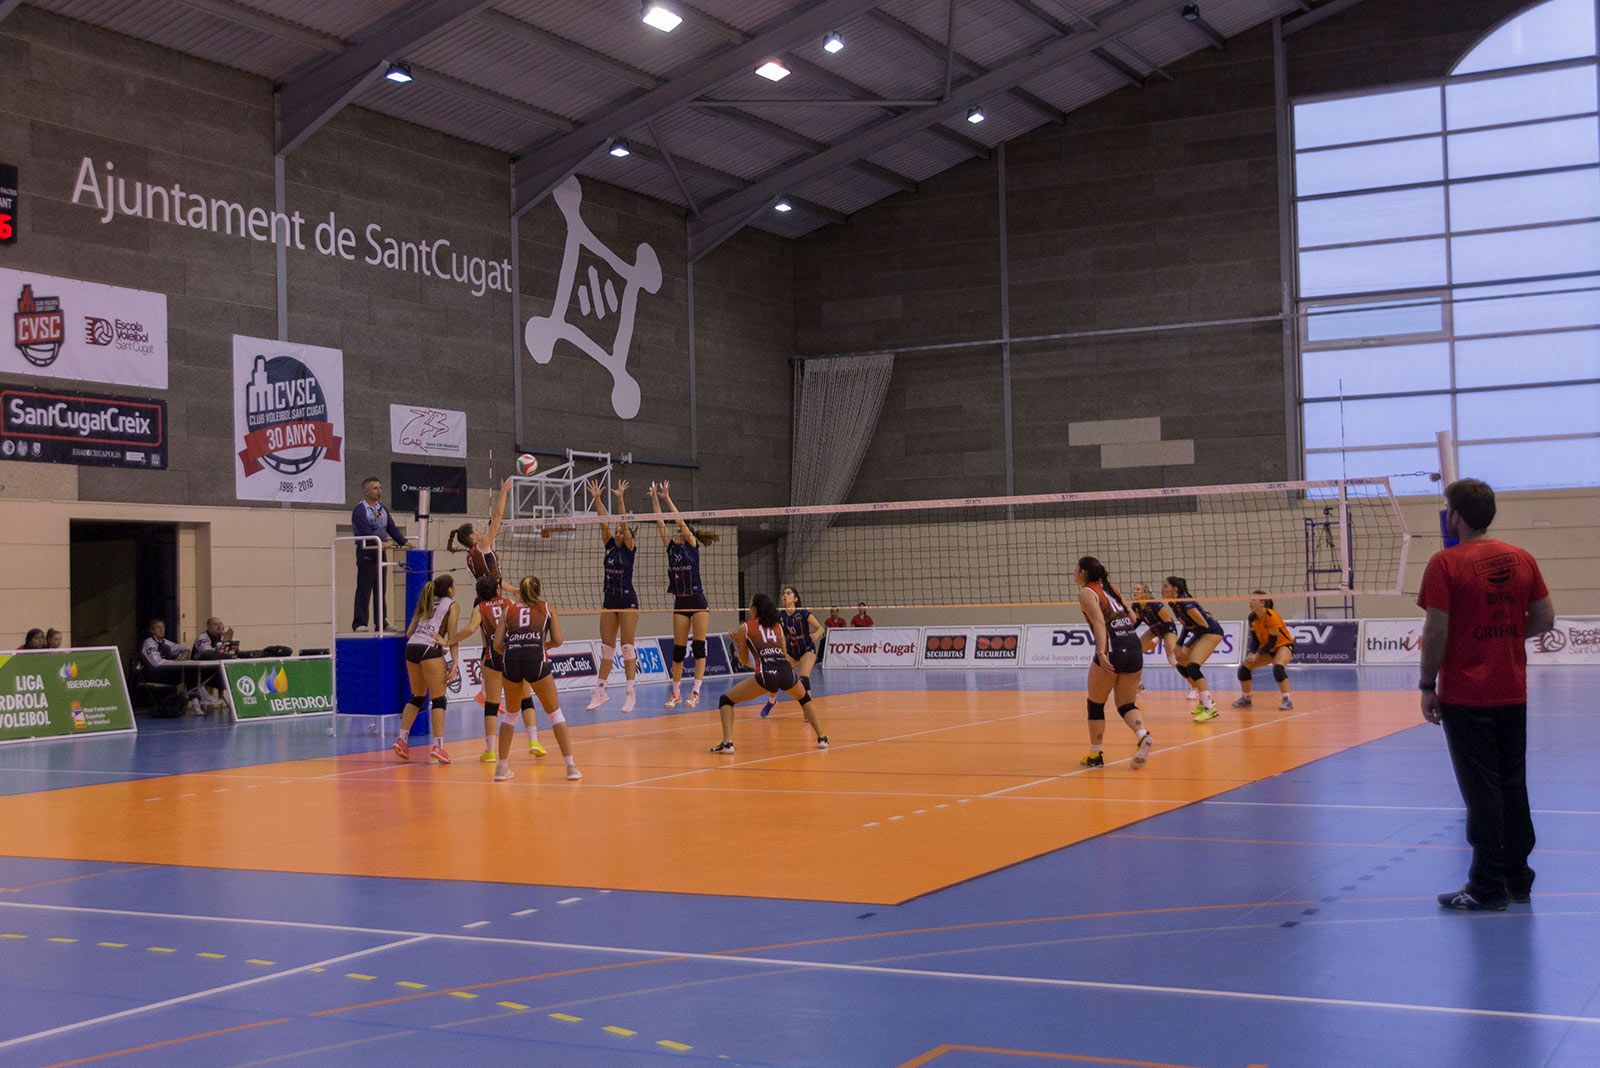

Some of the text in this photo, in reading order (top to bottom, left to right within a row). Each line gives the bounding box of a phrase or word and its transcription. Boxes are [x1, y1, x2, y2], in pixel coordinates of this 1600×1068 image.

[72, 156, 512, 297] Ajuntament de SantCugat
[19, 315, 61, 341] CVSC
[115, 318, 143, 331] Escola
[116, 328, 149, 343] Voleibol
[275, 376, 316, 409] CVSC
[10, 398, 151, 436] SantCugatCreix
[250, 404, 325, 425] CLUB VOLEIBOL SANT CUGAT
[266, 423, 316, 450] 30 ANYS
[279, 480, 293, 493] 1988
[298, 478, 314, 492] 2018
[519, 607, 530, 627] 6
[509, 631, 541, 641] GRIFOLS
[758, 624, 777, 643] 14
[829, 641, 915, 656] TOT Sant Cugat
[926, 650, 964, 658] SECURITAS
[976, 650, 1015, 658] SECURITAS
[1306, 652, 1319, 660] and
[1319, 652, 1348, 662] Logistics
[550, 657, 592, 676] ugatCreix
[1051, 653, 1078, 663] Transport
[15, 674, 45, 691] LIGA
[66, 678, 111, 689] IBERDROLA
[0, 692, 49, 711] RDROLA
